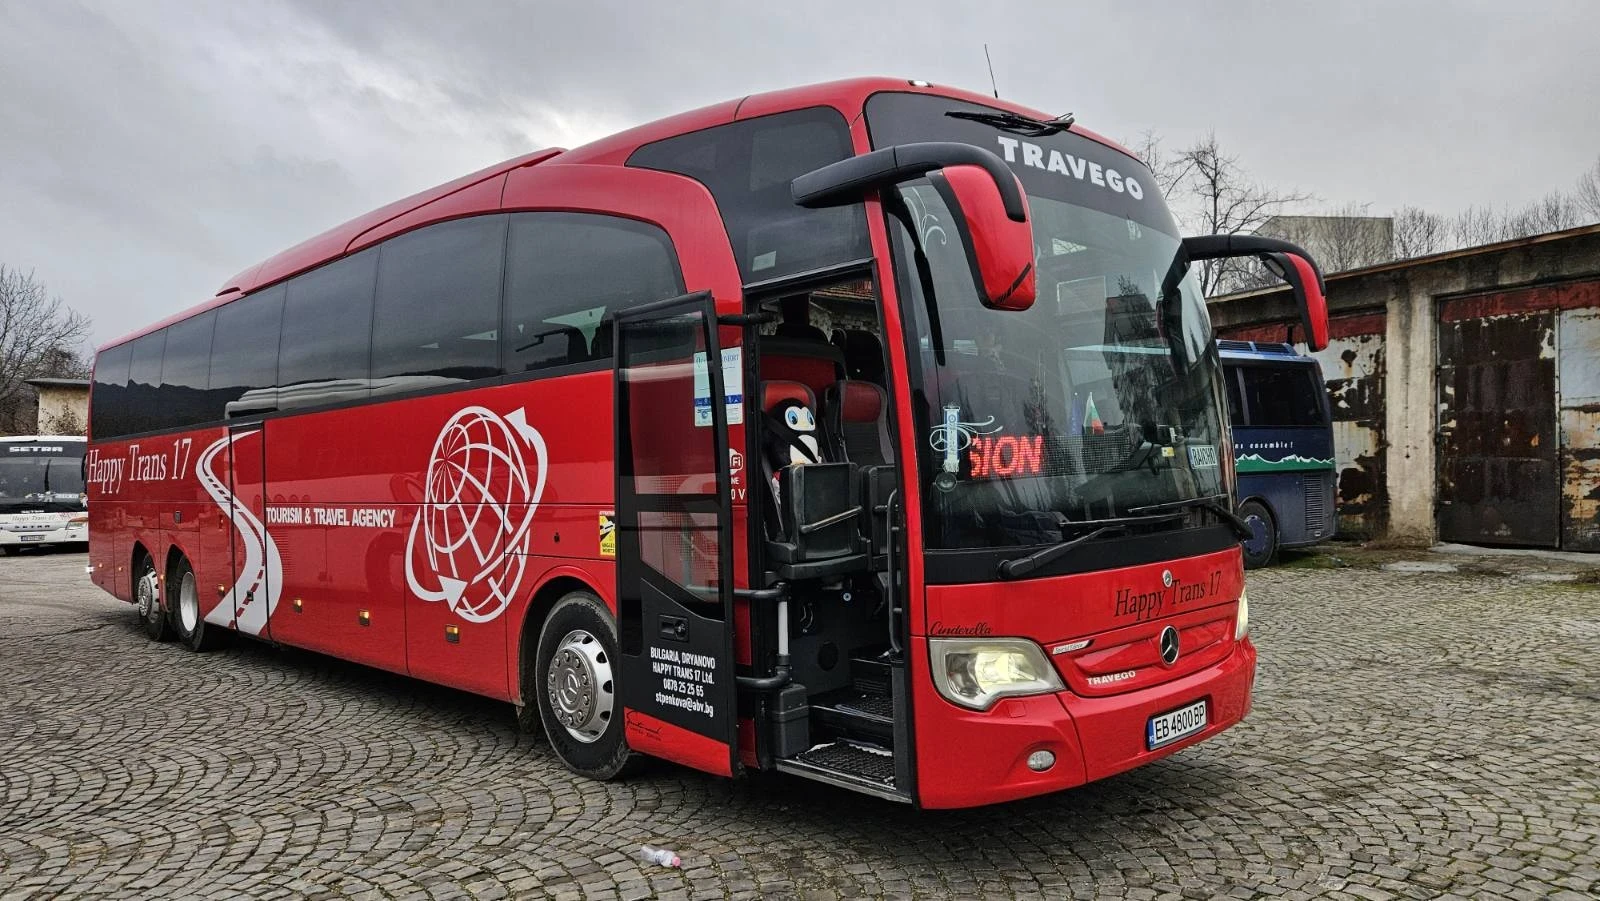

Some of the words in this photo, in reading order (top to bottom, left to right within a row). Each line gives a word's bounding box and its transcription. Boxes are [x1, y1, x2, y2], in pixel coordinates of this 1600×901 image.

[997, 135, 1143, 200] TRAVEGO
[88, 449, 126, 494] Happy
[129, 444, 167, 481] Trans
[171, 438, 192, 480] 17
[266, 507, 302, 524] TOURISM
[304, 508, 311, 524] &
[313, 508, 349, 526] TRAVEL
[351, 509, 396, 528] AGENCY
[1114, 588, 1166, 621] Happy
[1170, 579, 1206, 605] Trans
[1209, 570, 1222, 596] 17
[930, 621, 993, 636] Cinderella
[650, 646, 681, 664] BULGARIA,
[681, 652, 716, 669] DRYANOVO
[652, 661, 672, 676] HAPPY
[673, 665, 693, 680] TRANS
[694, 669, 701, 681] 17
[702, 671, 715, 684] Ltd.
[1086, 670, 1136, 685] TRAVEGO
[663, 678, 678, 691] 0878
[678, 681, 686, 694] 25
[687, 683, 695, 695] 25
[695, 685, 704, 697] 65
[655, 691, 714, 717] stpenkova@abv.bg
[1171, 709, 1193, 734] 4800
